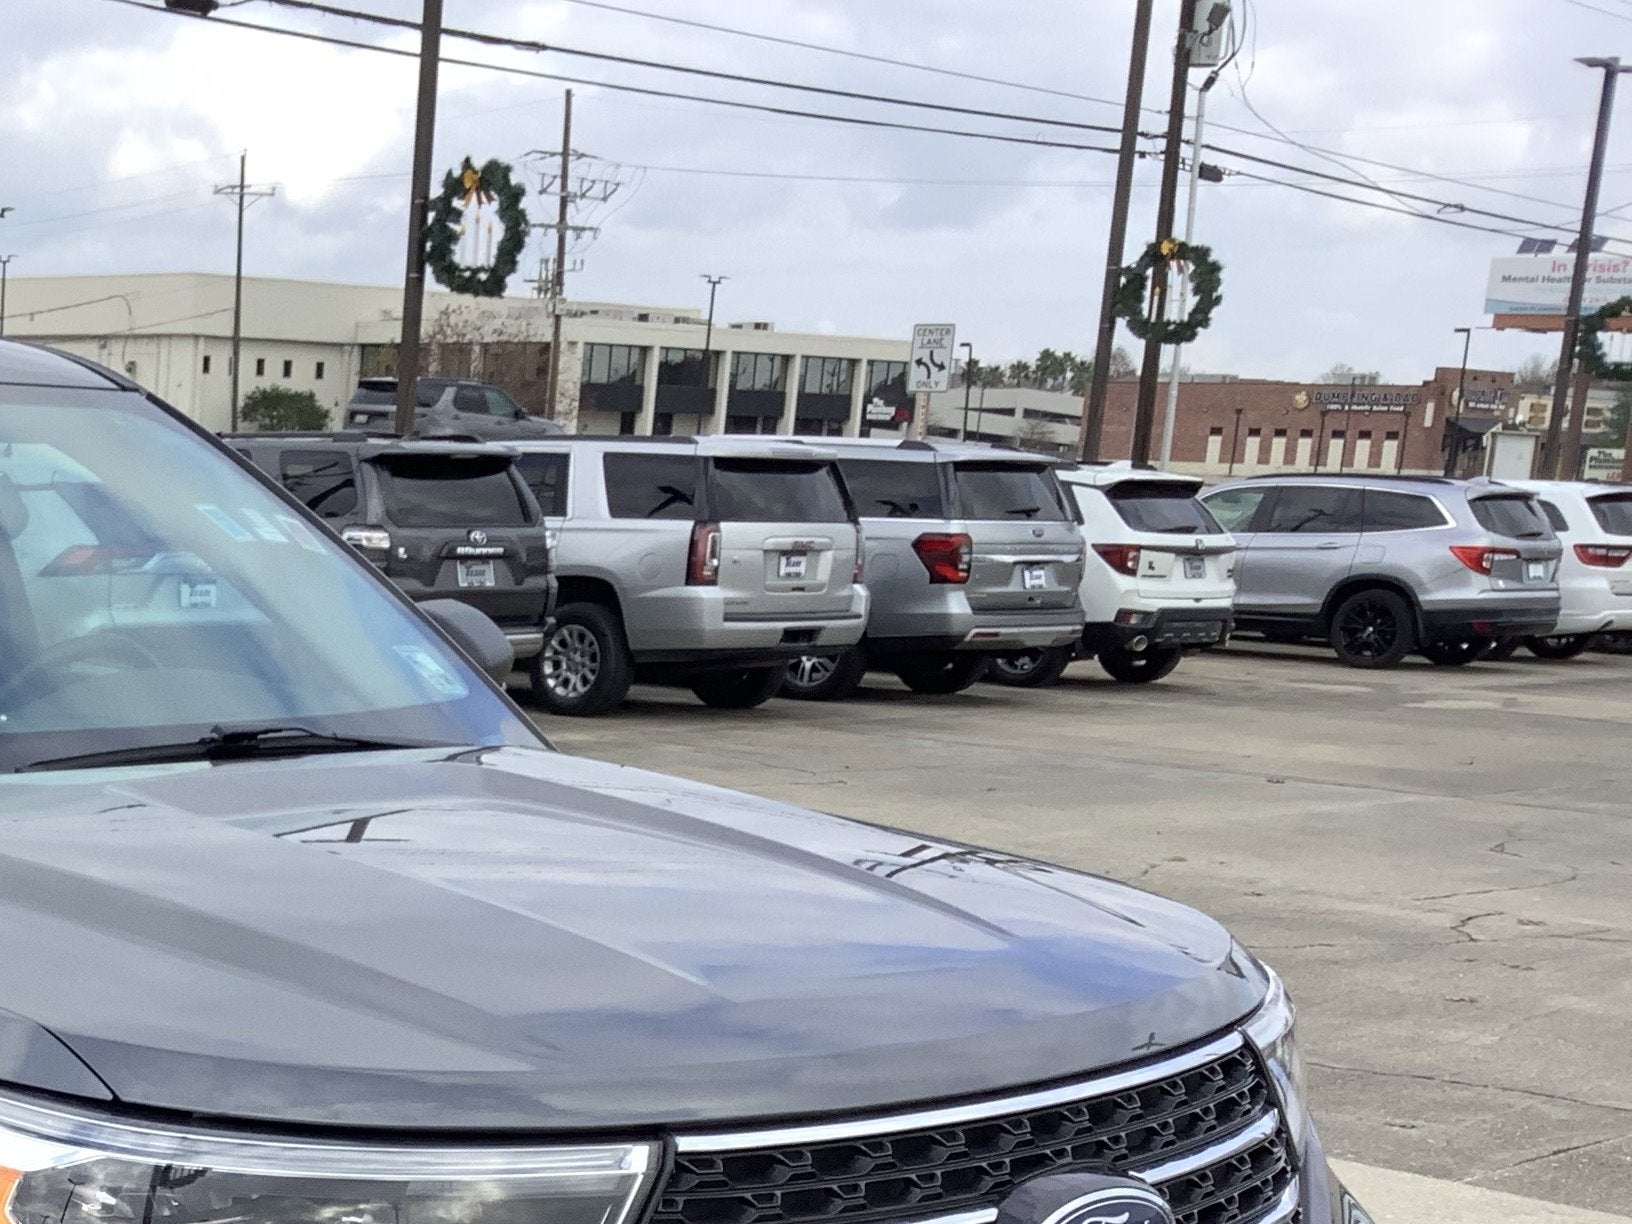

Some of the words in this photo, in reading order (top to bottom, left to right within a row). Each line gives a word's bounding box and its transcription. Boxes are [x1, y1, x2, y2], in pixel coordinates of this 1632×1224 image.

[1551, 260, 1568, 273] In
[1579, 259, 1630, 273] risis?
[1501, 274, 1539, 284] Mental
[1541, 274, 1574, 284] Healt
[917, 327, 951, 337] CENTER
[921, 337, 945, 347] LANE
[916, 380, 940, 390] ONLY
